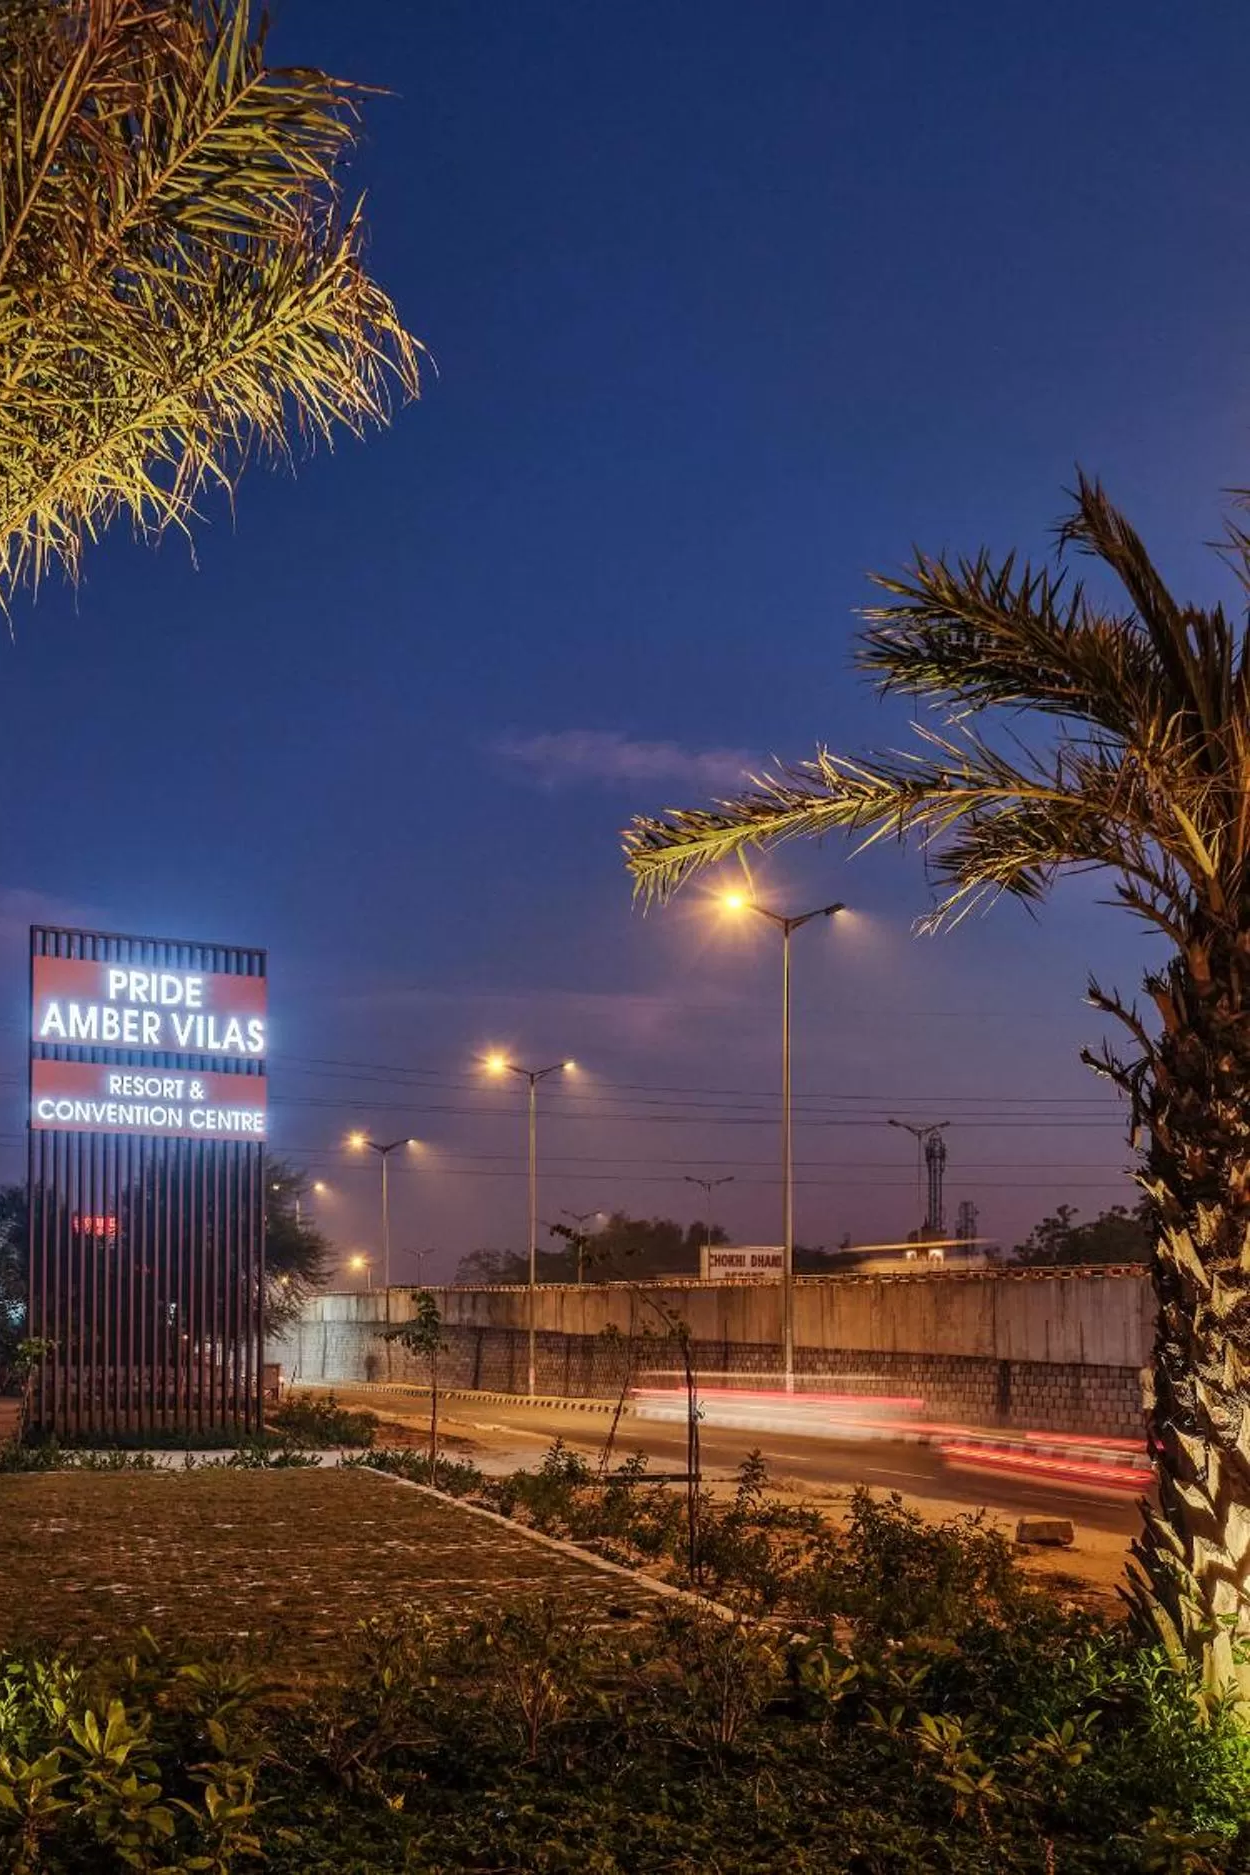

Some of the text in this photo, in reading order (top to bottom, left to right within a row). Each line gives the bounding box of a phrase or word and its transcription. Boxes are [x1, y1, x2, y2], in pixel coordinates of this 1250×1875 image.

[108, 969, 203, 1008] PRIDE
[40, 1003, 265, 1053] AMBER VILAS
[109, 1075, 205, 1100] RESORT &
[37, 1099, 264, 1133] CONVENTION CENTRE
[709, 1254, 746, 1267] CHOKHI
